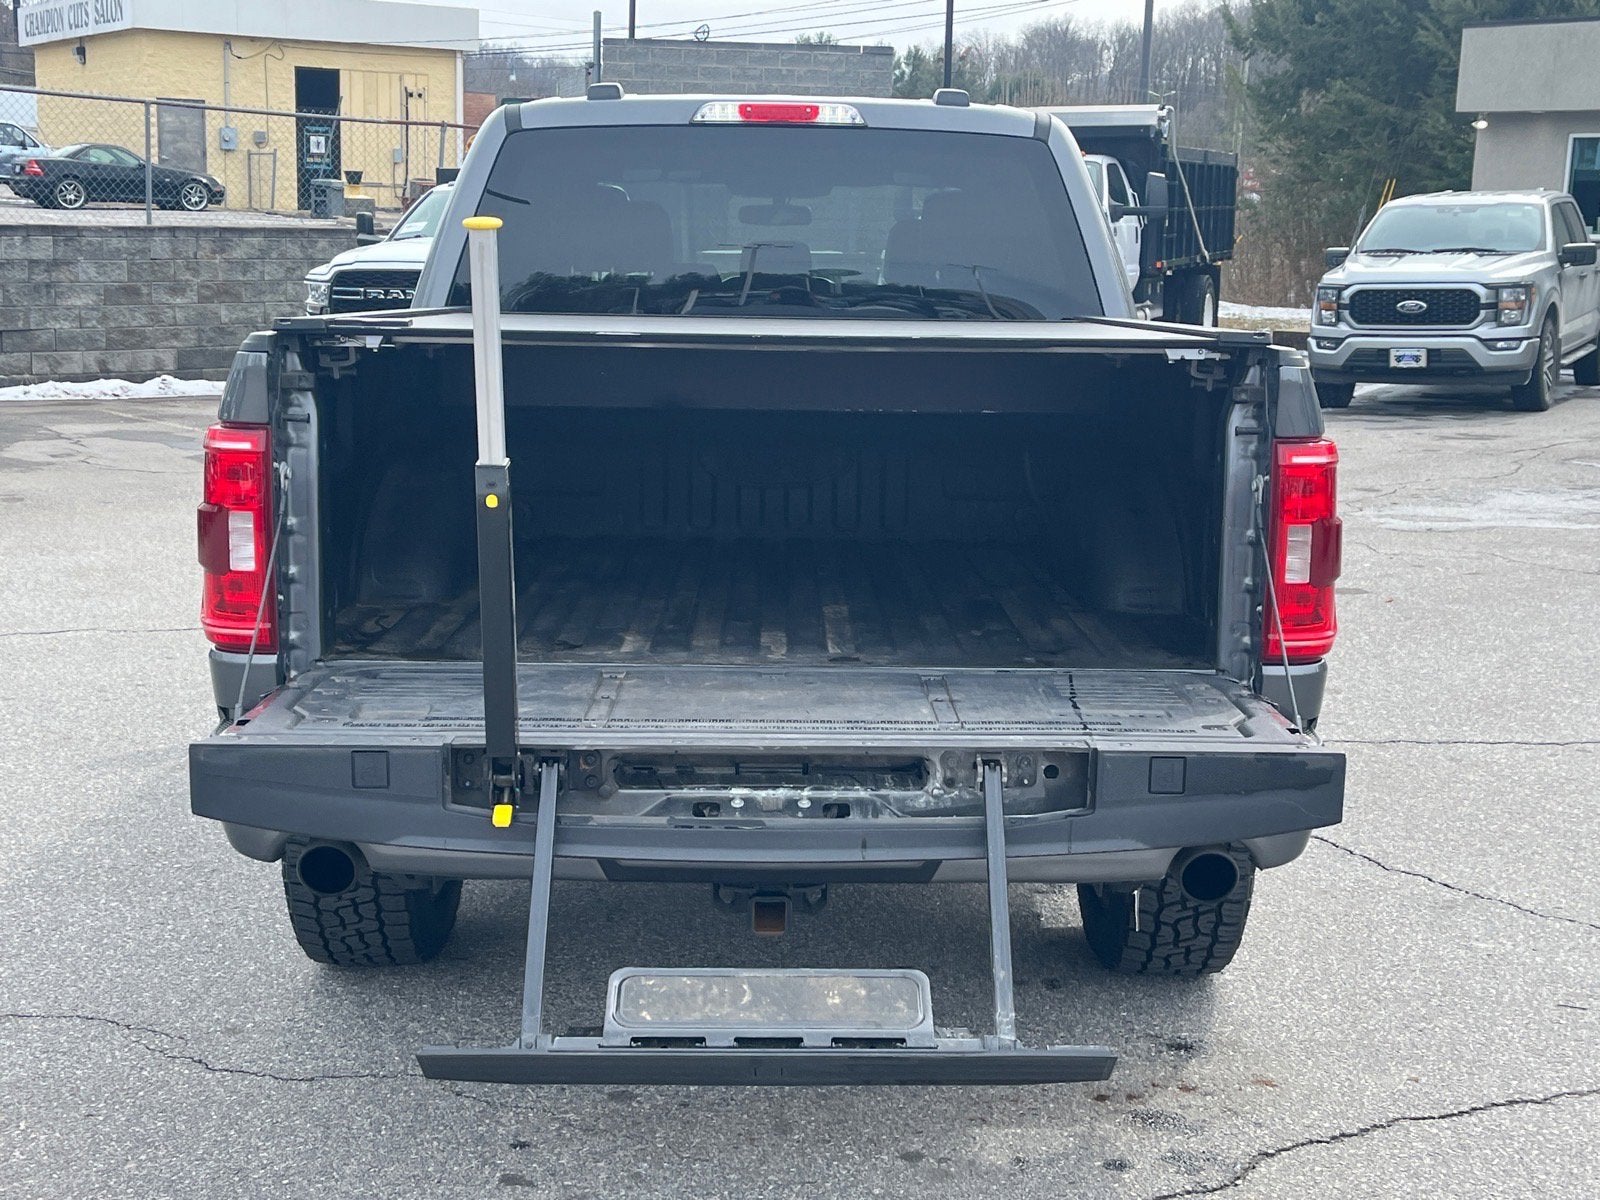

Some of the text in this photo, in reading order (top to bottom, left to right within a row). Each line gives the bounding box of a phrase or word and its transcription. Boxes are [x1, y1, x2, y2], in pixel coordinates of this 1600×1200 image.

[25, 0, 124, 37] CHAMPION CUTS SALON
